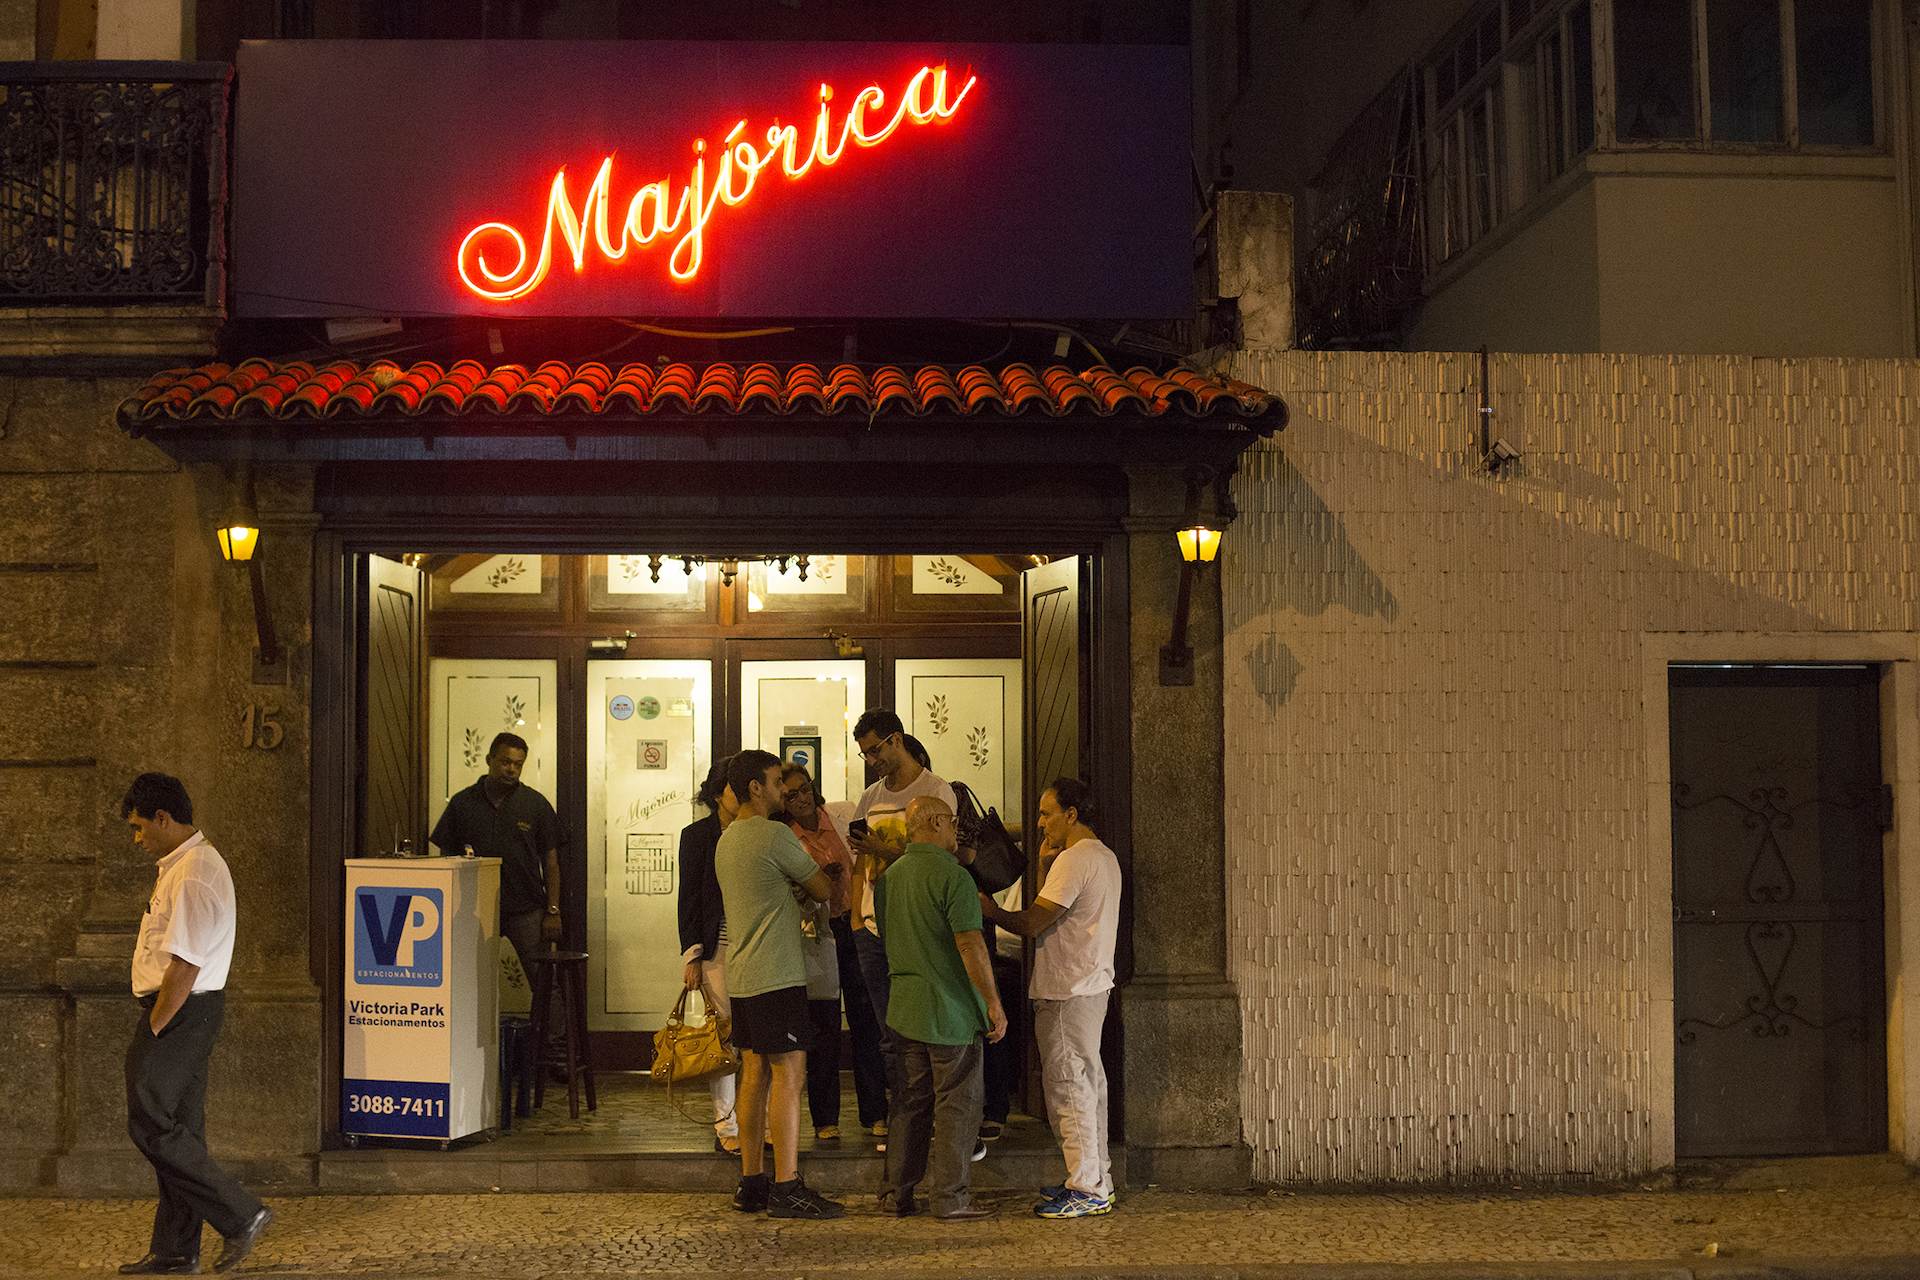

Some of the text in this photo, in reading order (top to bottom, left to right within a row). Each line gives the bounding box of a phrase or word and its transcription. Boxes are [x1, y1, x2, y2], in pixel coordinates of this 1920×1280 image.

[458, 62, 977, 301] Majórica
[240, 703, 283, 749] 15
[358, 894, 440, 968] VP
[348, 1015, 445, 1028] Estacionamentos
[350, 1000, 445, 1016] Victoria Park
[349, 1094, 444, 1117] 3088-7411
